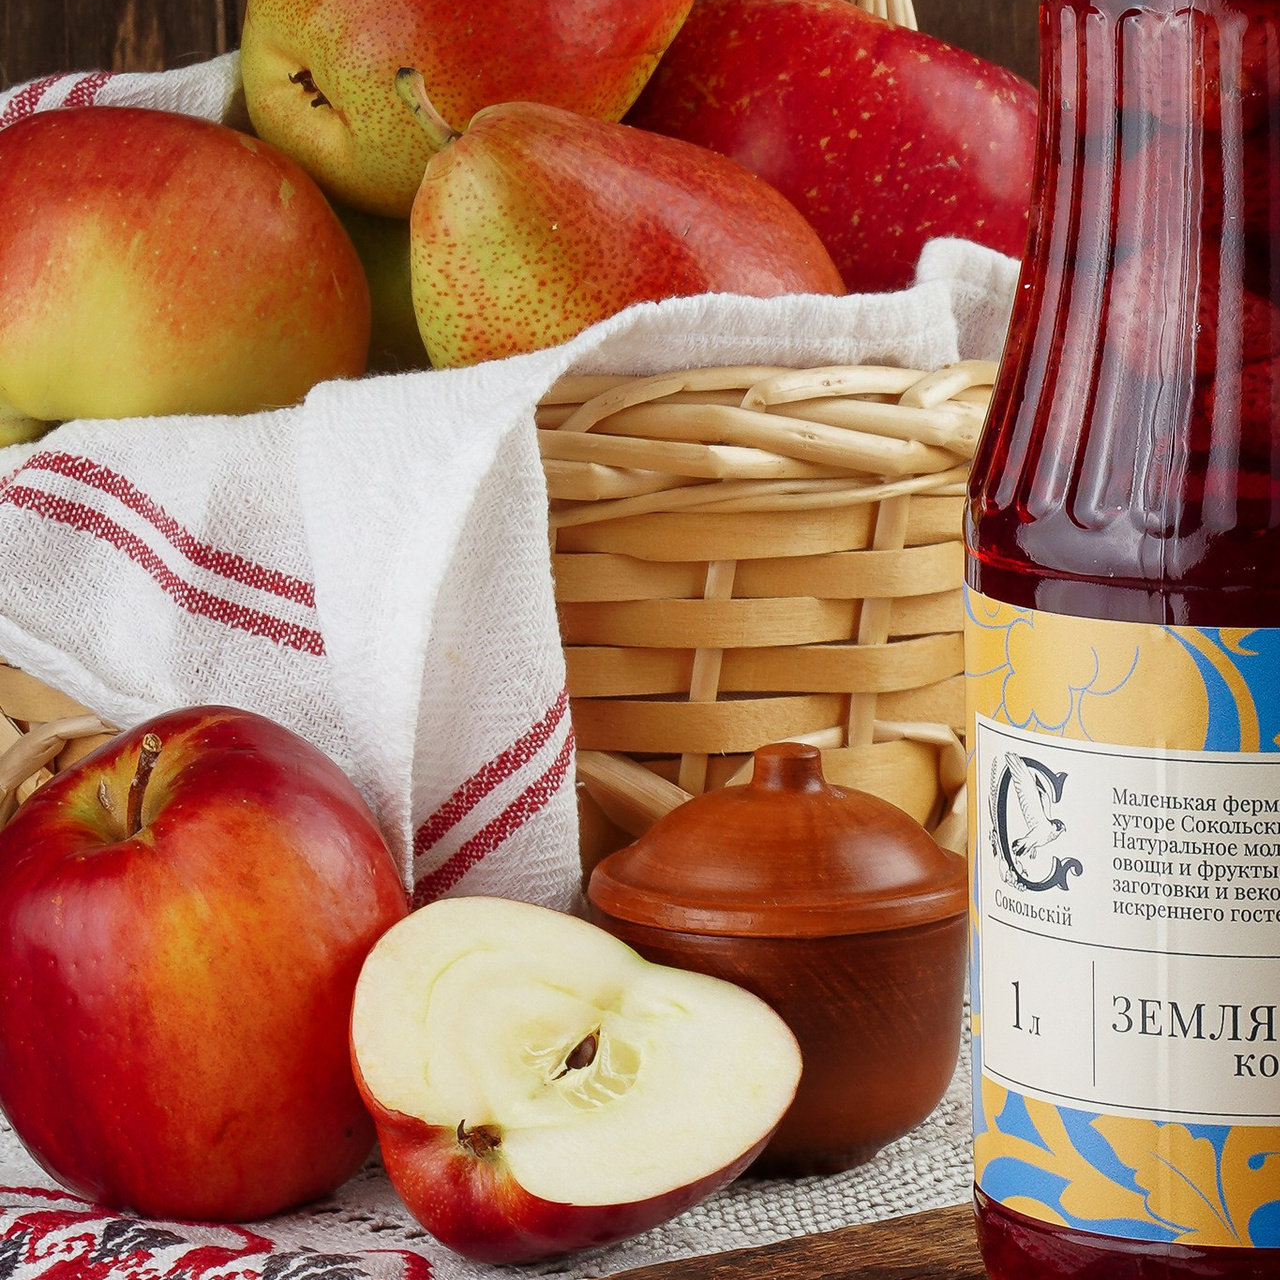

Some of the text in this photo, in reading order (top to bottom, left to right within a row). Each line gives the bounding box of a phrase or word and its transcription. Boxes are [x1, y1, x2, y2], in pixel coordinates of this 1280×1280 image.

[1112, 787, 1217, 812] Маленькая
[1112, 813, 1175, 833] хуторе
[1112, 831, 1238, 858] Натуральное
[1112, 855, 1174, 877] овощи
[1179, 862, 1192, 875] и
[1112, 879, 1210, 899] заготовки
[1215, 887, 1228, 899] и
[994, 888, 1074, 927] Сокольскій
[1112, 899, 1224, 921] искреннего
